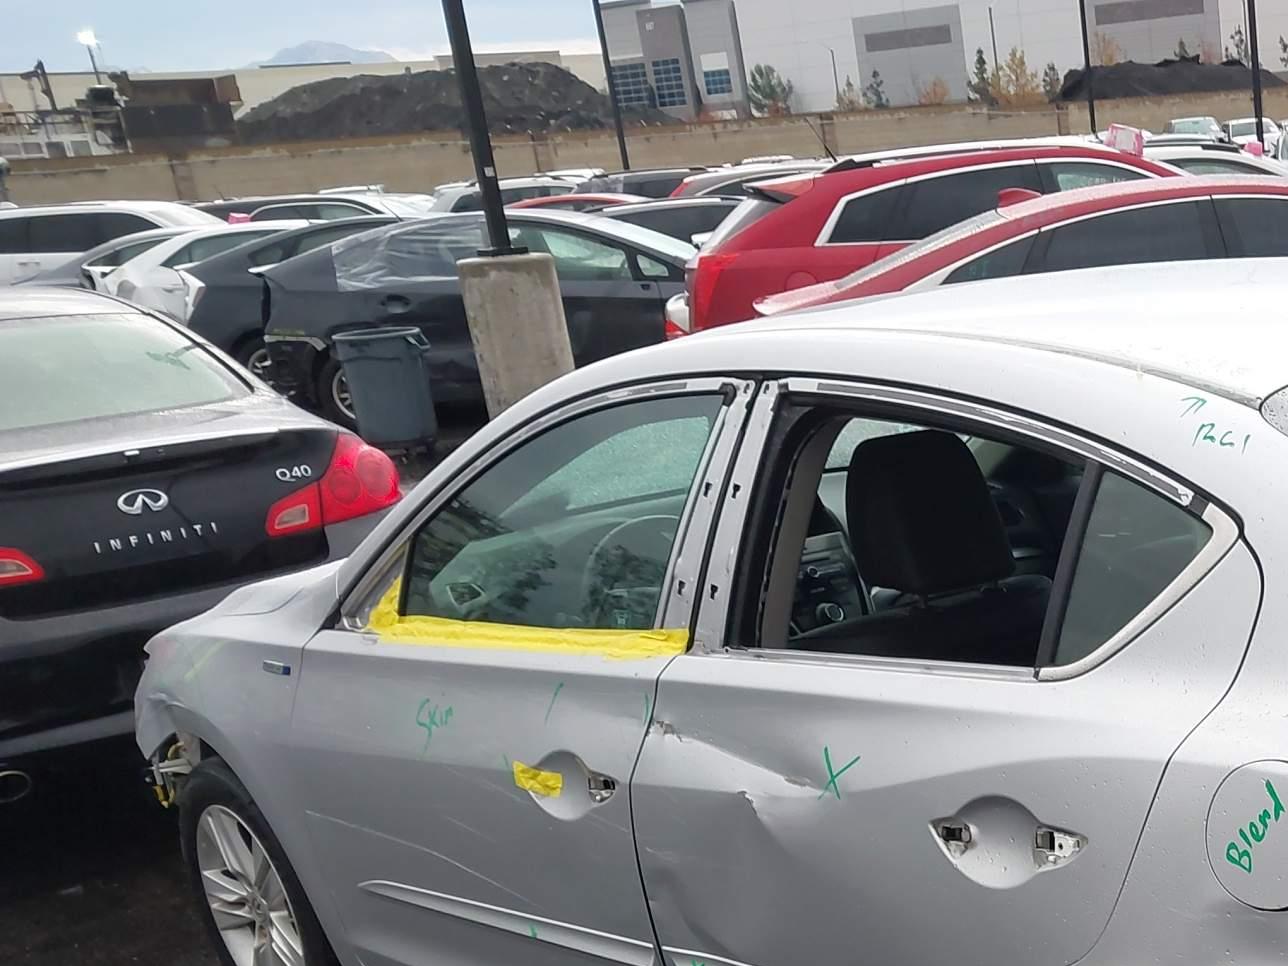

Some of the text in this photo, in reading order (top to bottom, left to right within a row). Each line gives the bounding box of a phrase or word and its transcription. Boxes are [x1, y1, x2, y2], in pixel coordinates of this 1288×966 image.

[275, 464, 312, 482] Q40
[94, 521, 218, 554] INFINITI
[1225, 778, 1286, 874] Blend
